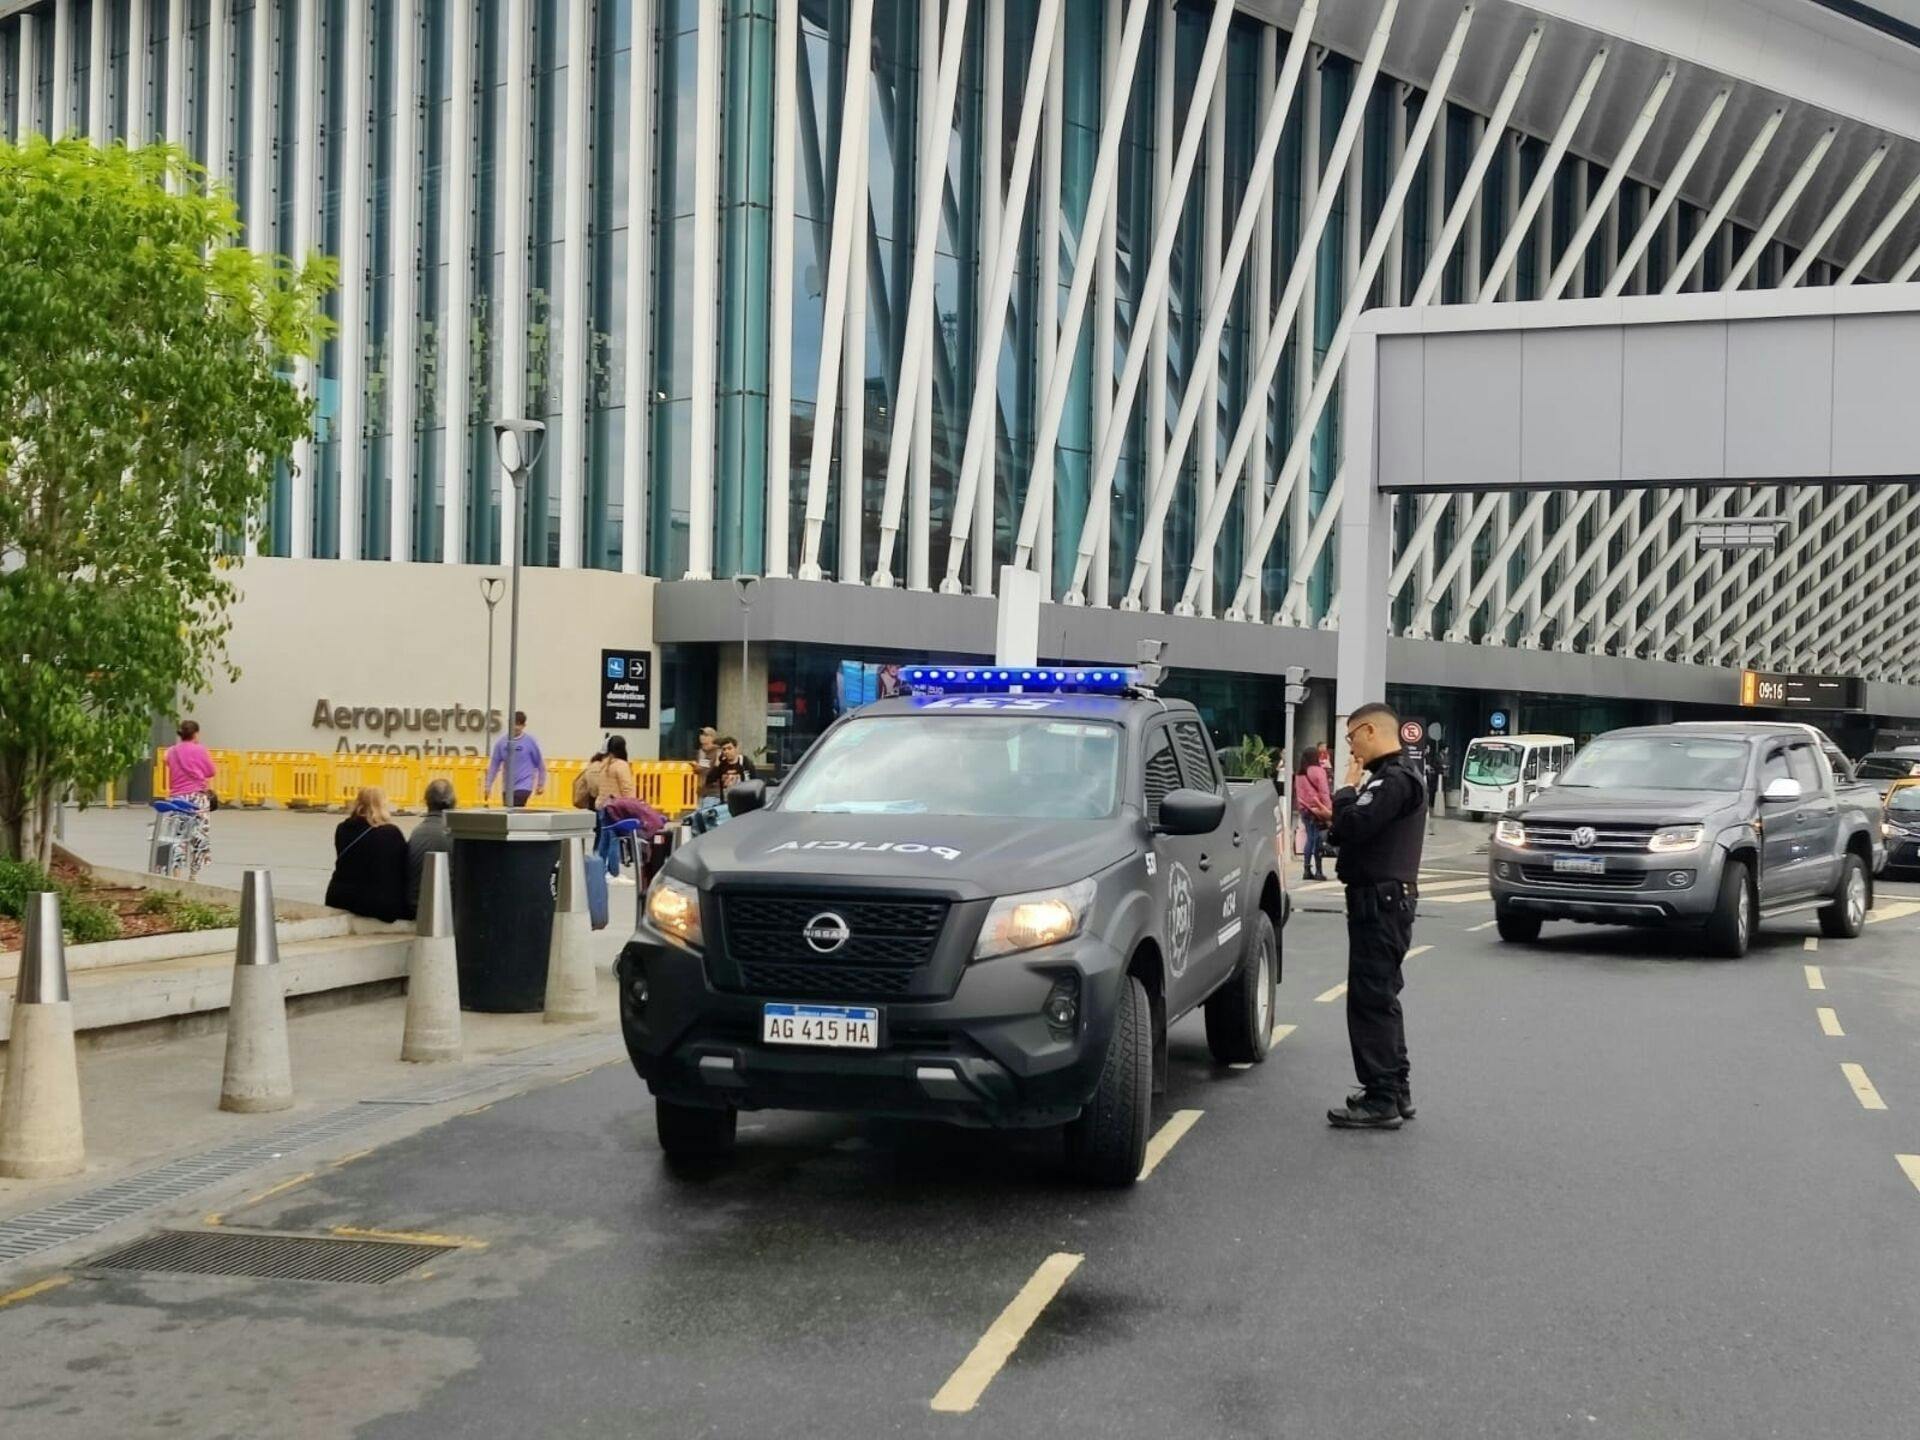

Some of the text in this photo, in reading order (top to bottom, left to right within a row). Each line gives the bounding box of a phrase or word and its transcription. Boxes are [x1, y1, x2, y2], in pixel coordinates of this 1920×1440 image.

[1758, 682, 1783, 700] 09:16
[311, 699, 503, 738] Aeropuertos
[803, 928, 849, 940] NISSAN
[770, 1018, 870, 1043] AG 415 HA
